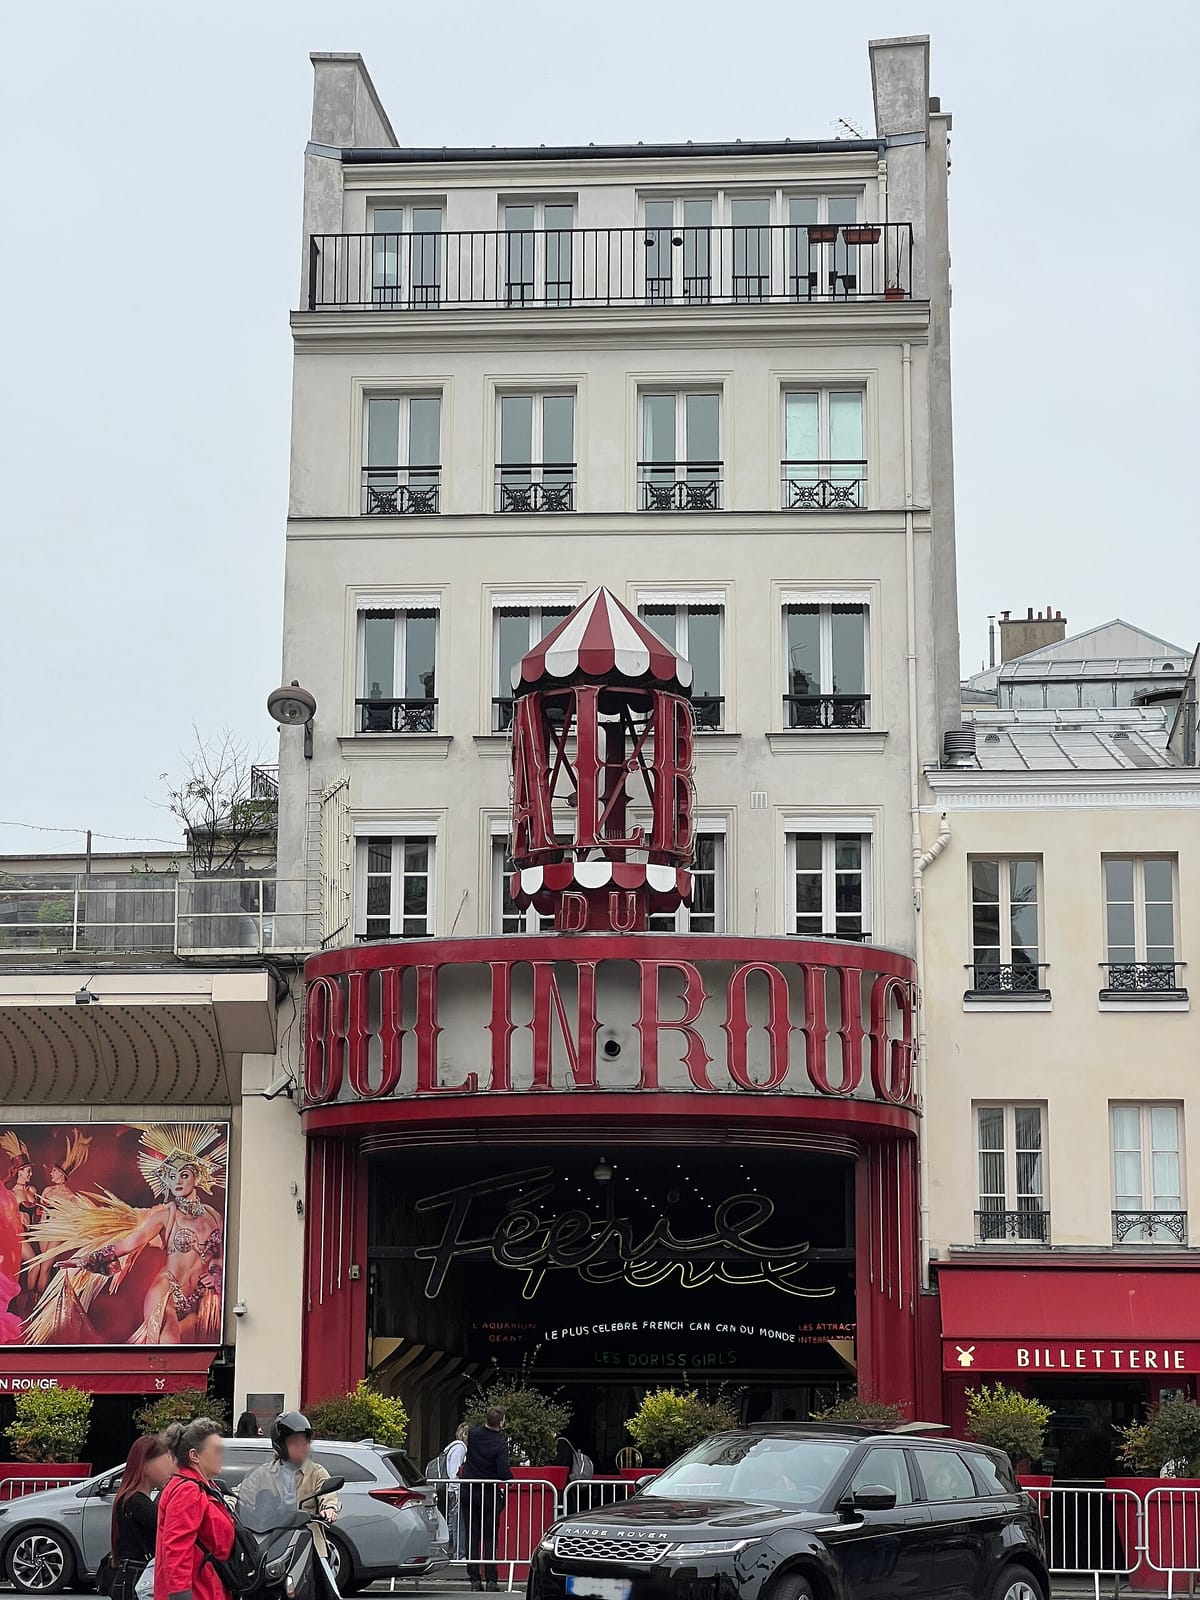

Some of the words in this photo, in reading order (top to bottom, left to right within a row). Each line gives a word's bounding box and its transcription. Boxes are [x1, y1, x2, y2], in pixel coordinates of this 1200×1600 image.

[558, 889, 638, 932] DU
[303, 958, 605, 1104] OULIN
[634, 958, 918, 1105] ROUG
[414, 1165, 811, 1300] Féerie
[544, 1330, 559, 1341] LE
[561, 1326, 590, 1338] PLUS
[592, 1321, 638, 1333] CELEBRE
[642, 1321, 684, 1330] FRENCH
[689, 1322, 711, 1331] CAN
[715, 1323, 736, 1333] CAN
[740, 1325, 754, 1335] DU
[759, 1327, 796, 1343] MONDE
[594, 1351, 621, 1364] LES
[627, 1353, 687, 1366] DORISS
[691, 1350, 737, 1367] GIRLS
[1016, 1348, 1185, 1369] BILLETTERIE
[12, 1378, 58, 1389] ROUGE
[565, 1528, 609, 1536] RANGE
[617, 1531, 668, 1539] ROVER
